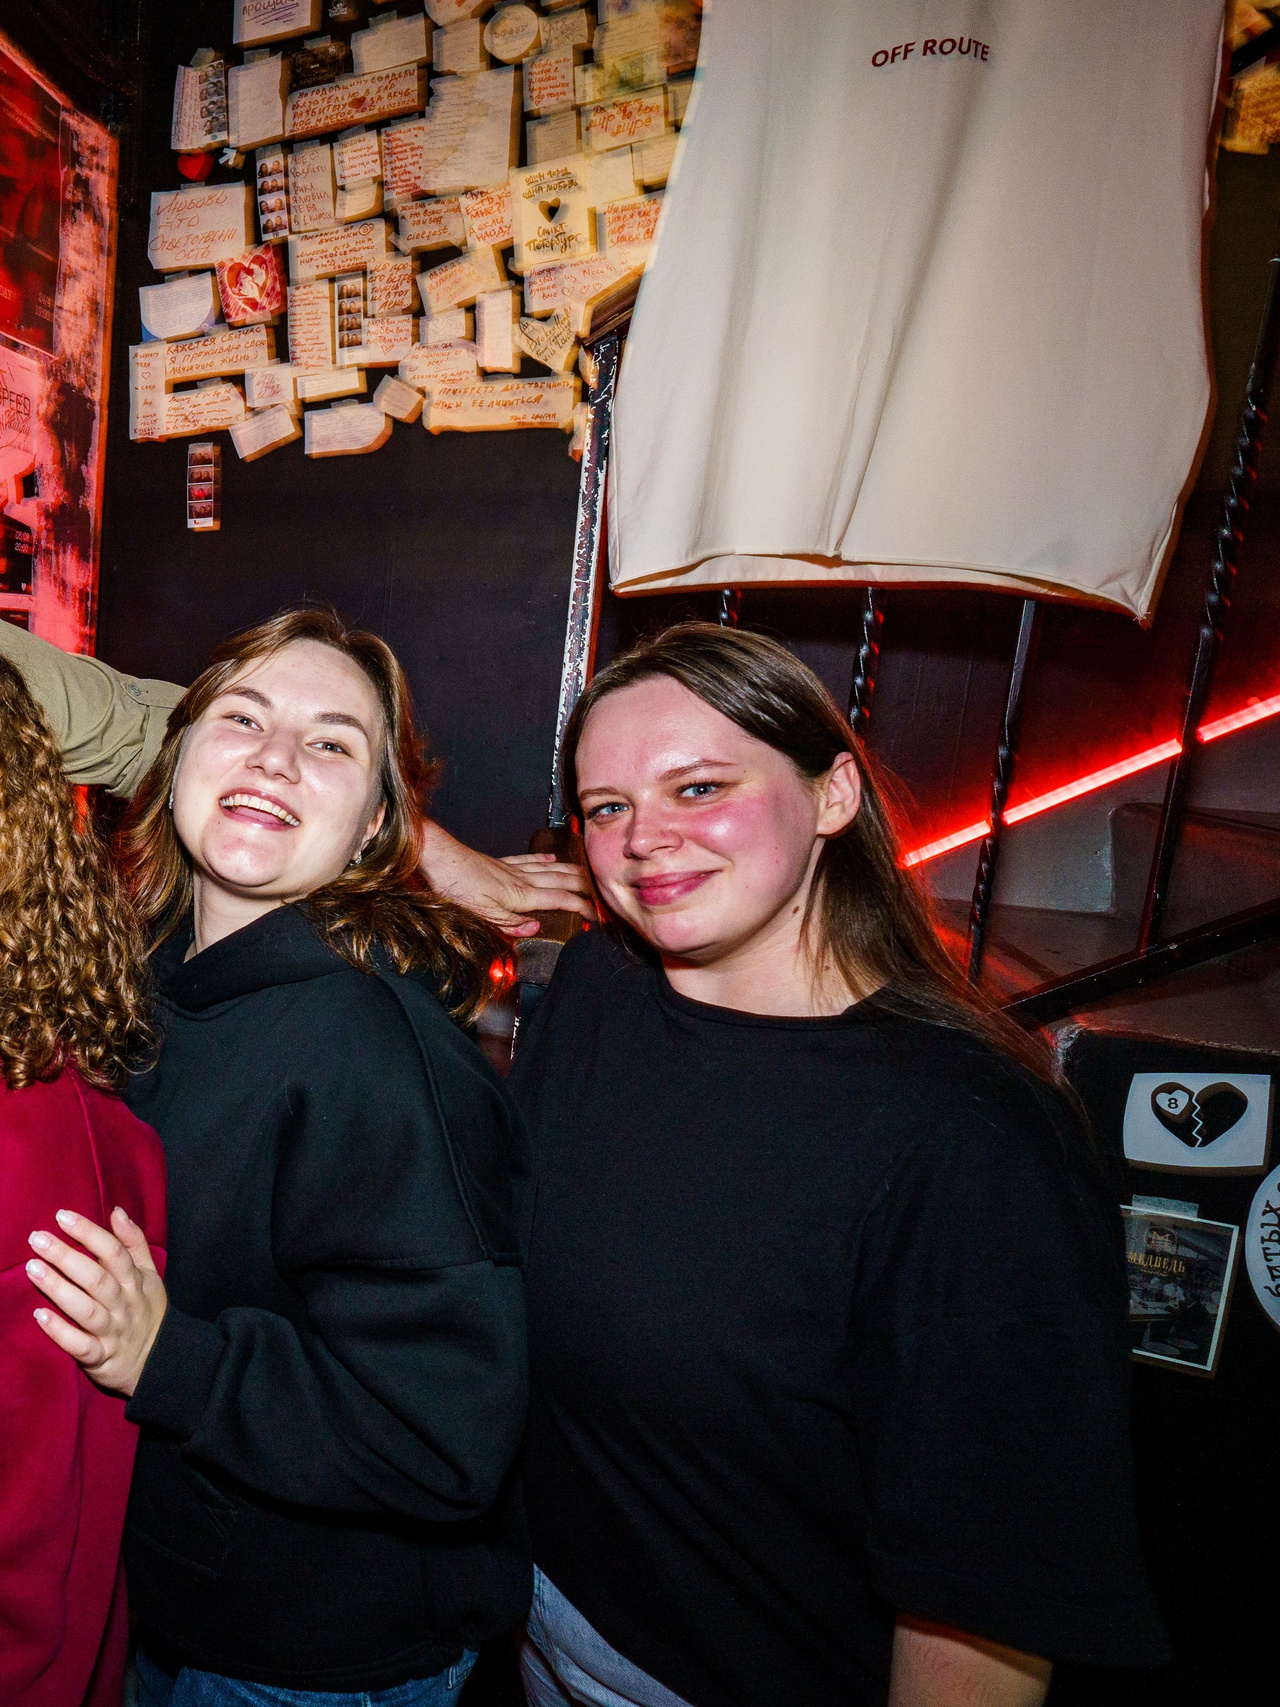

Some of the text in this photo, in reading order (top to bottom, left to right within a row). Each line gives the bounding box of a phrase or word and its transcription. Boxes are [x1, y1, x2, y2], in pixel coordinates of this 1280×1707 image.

[871, 36, 991, 68] OFF ROUTE
[221, 326, 262, 342] СЕЙЧАС
[168, 339, 267, 365] Я ПРОЖИВАЮ СВОЮ
[438, 385, 496, 396] ПРИОБРЕТУ
[471, 396, 485, 408] ЕЁ
[1167, 1097, 1179, 1110] 8
[1127, 1250, 1186, 1274] МЕДВЕДЬ
